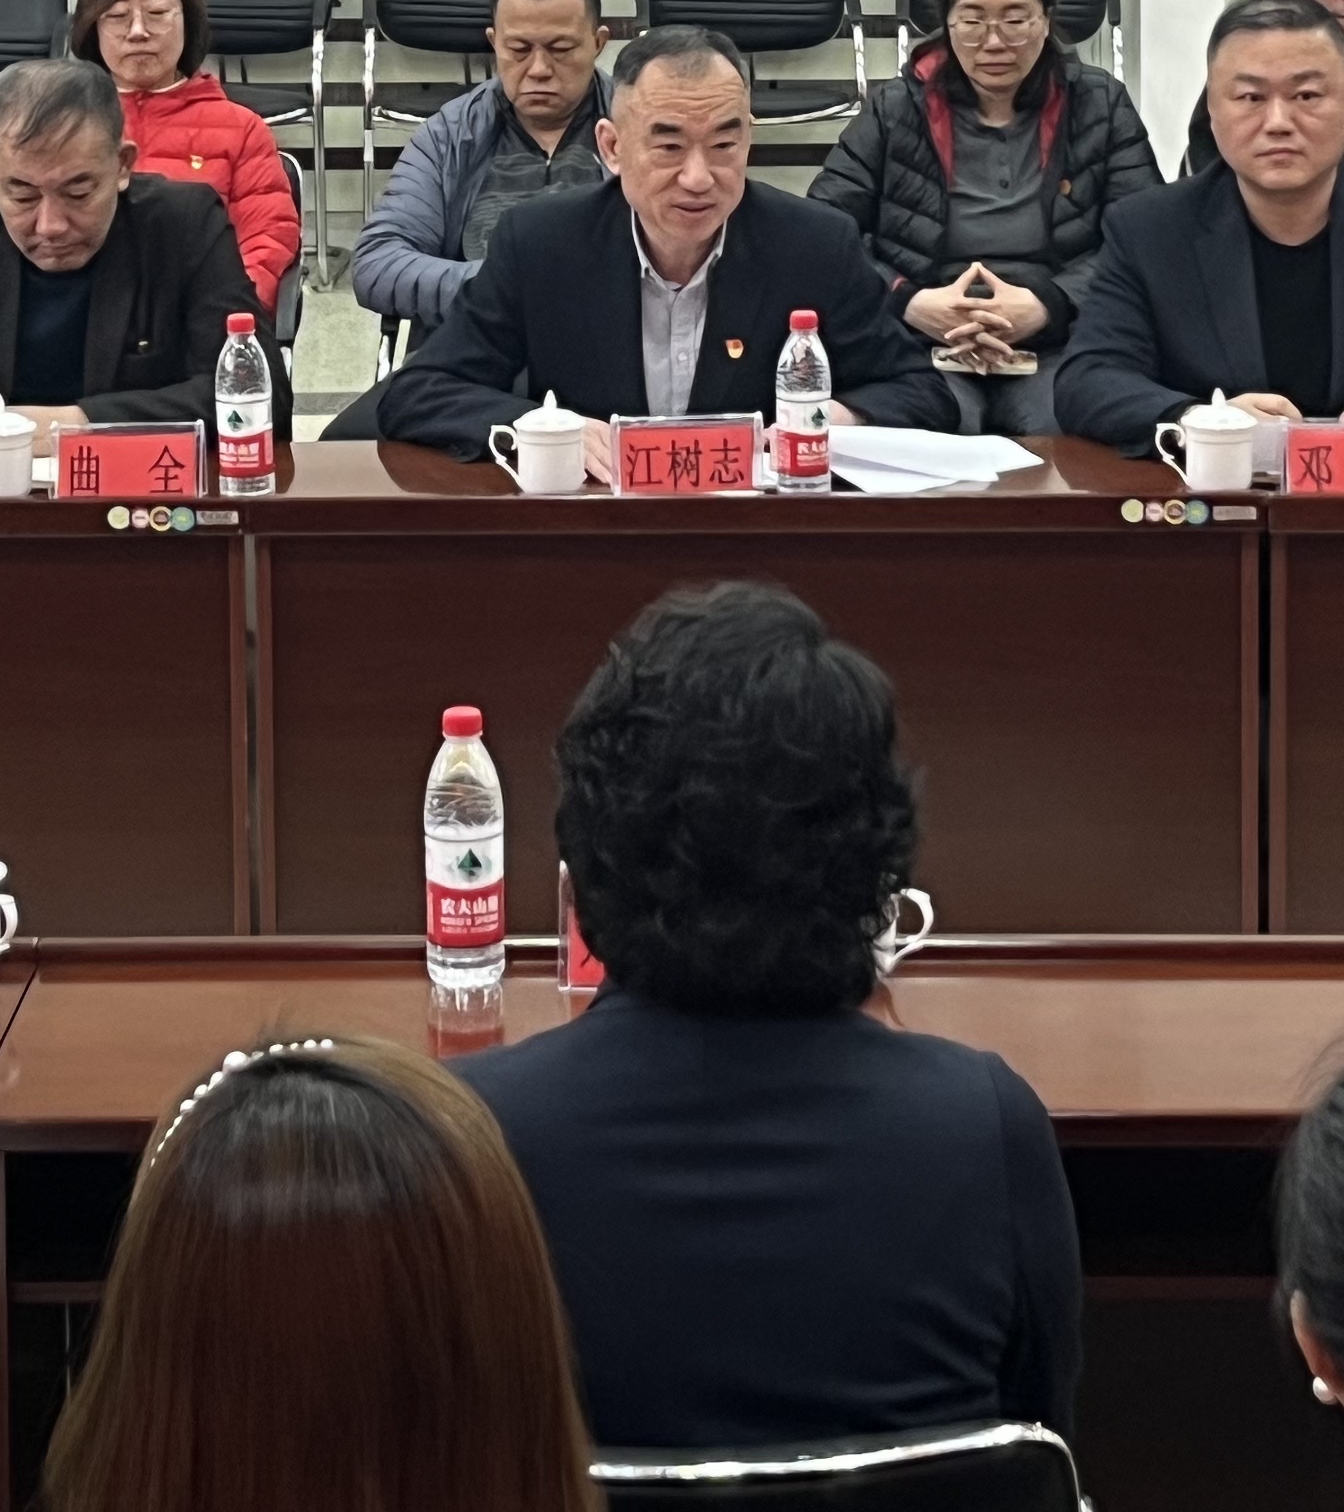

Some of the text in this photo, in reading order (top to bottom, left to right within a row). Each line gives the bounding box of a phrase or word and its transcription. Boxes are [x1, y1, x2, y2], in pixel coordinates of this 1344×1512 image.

[70, 445, 100, 496] 曲
[147, 444, 186, 494] 全
[626, 437, 746, 491] 江树志
[1293, 445, 1333, 492] 邓
